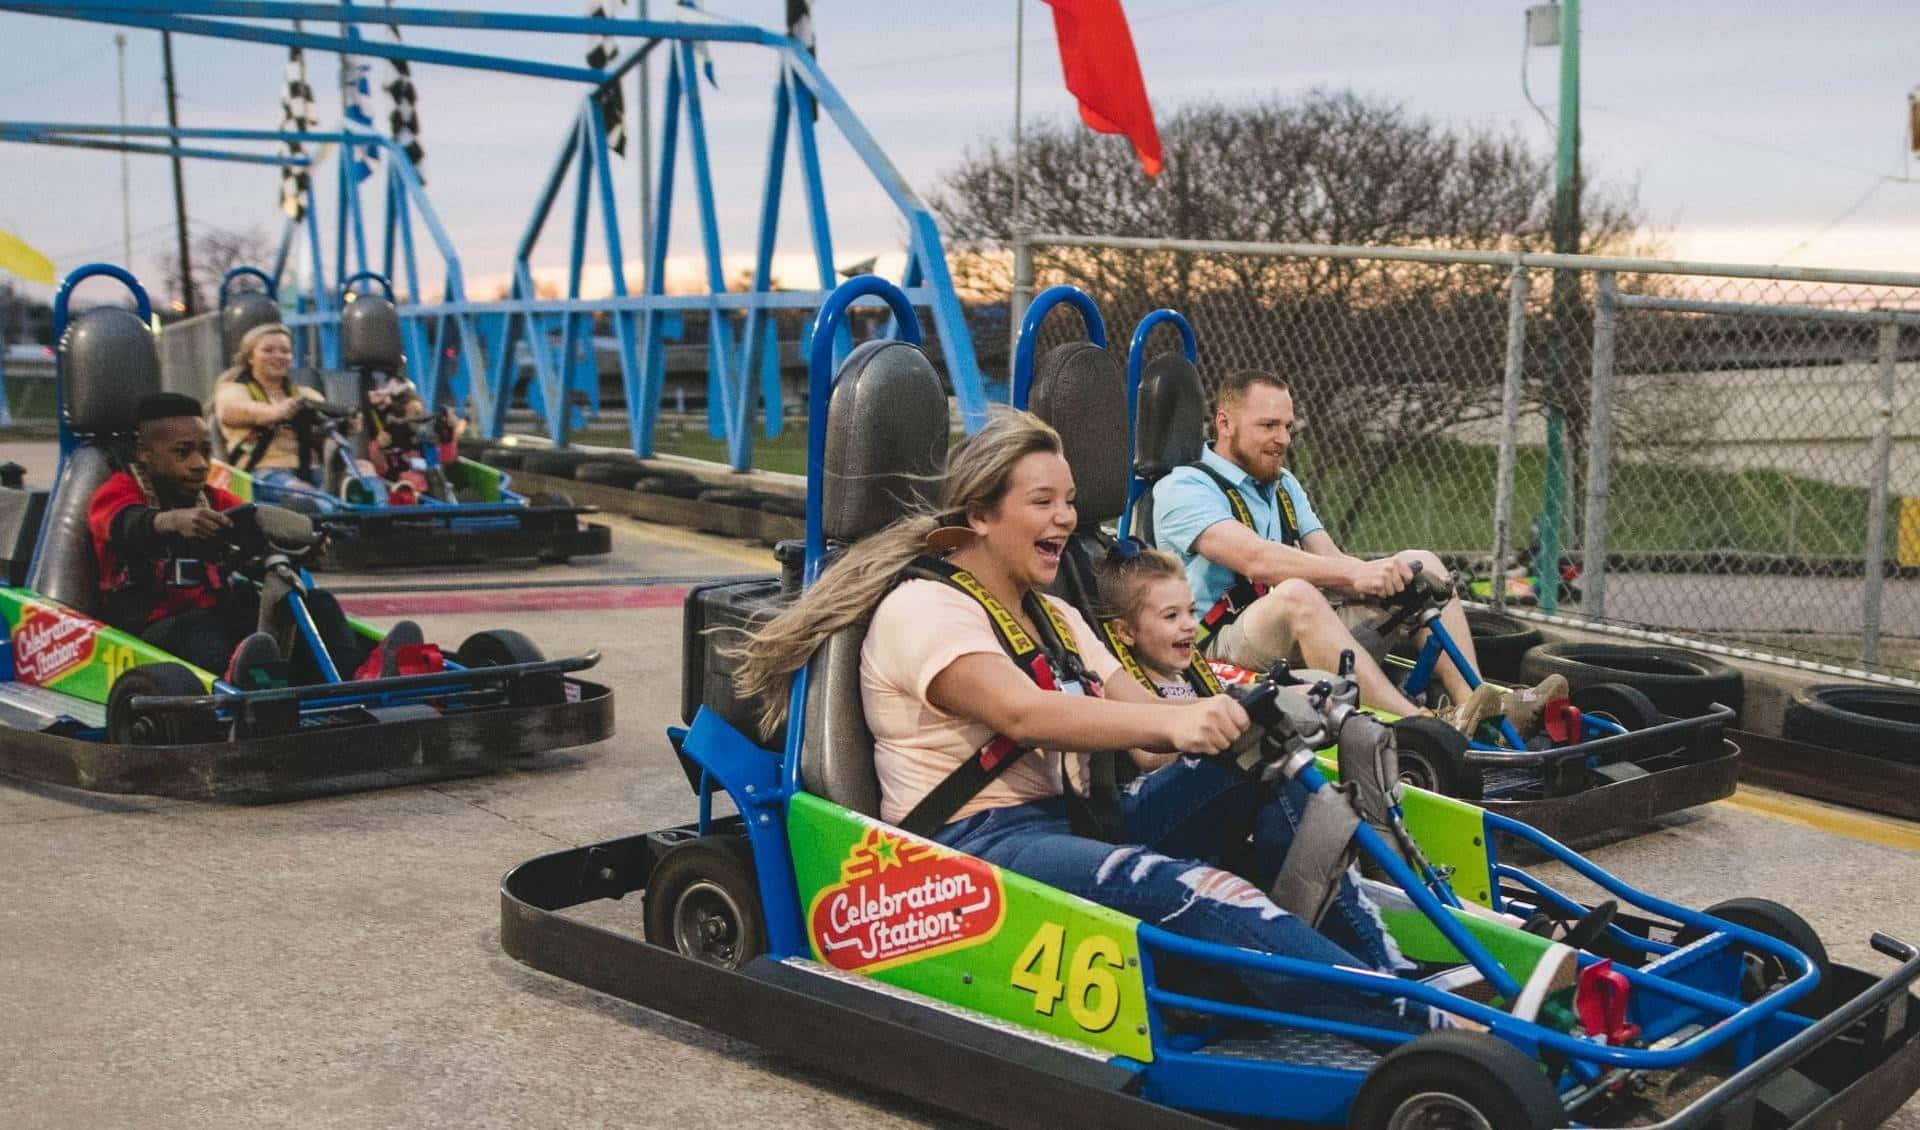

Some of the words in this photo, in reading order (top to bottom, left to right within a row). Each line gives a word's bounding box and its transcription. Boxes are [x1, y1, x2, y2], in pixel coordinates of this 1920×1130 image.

[830, 873, 977, 934] Celebration
[861, 911, 962, 959] Station
[1010, 920, 1125, 1033] 46
